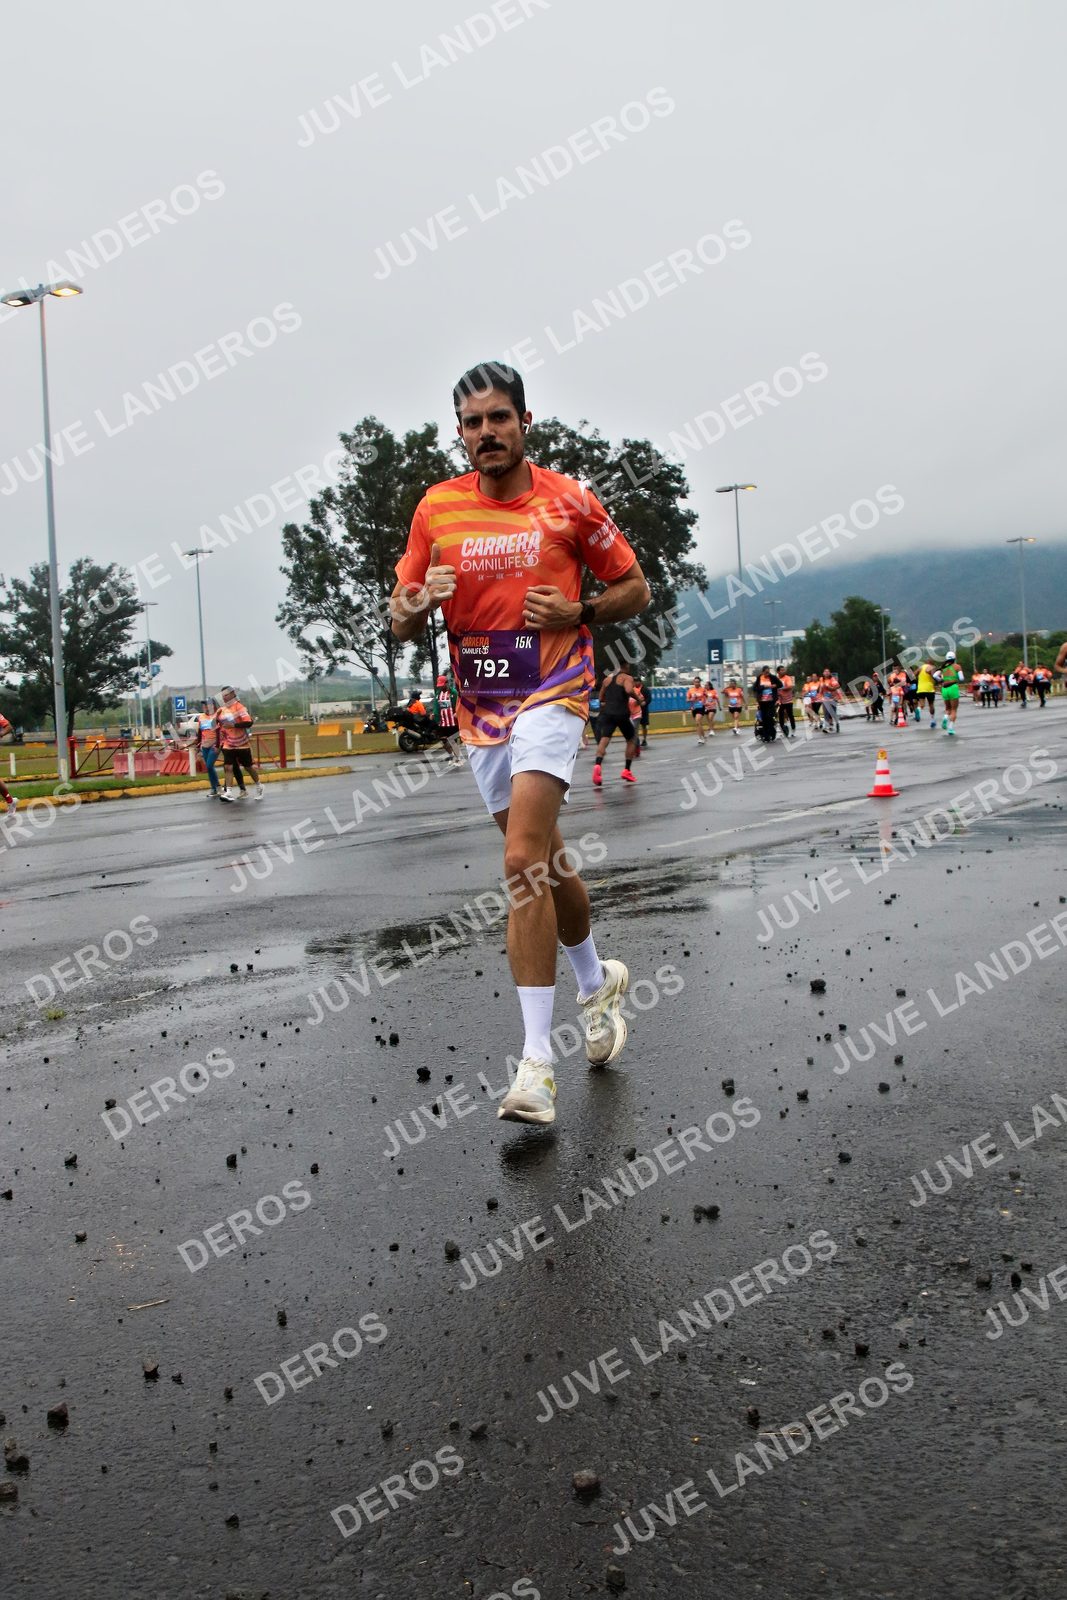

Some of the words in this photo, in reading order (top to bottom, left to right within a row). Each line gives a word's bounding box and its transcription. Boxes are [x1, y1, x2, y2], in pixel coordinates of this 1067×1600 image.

[461, 531, 541, 557] CARRERA
[460, 556, 521, 572] OMNILIFE
[462, 636, 490, 647] CARRERA
[710, 649, 720, 661] E
[473, 659, 510, 678] 792
